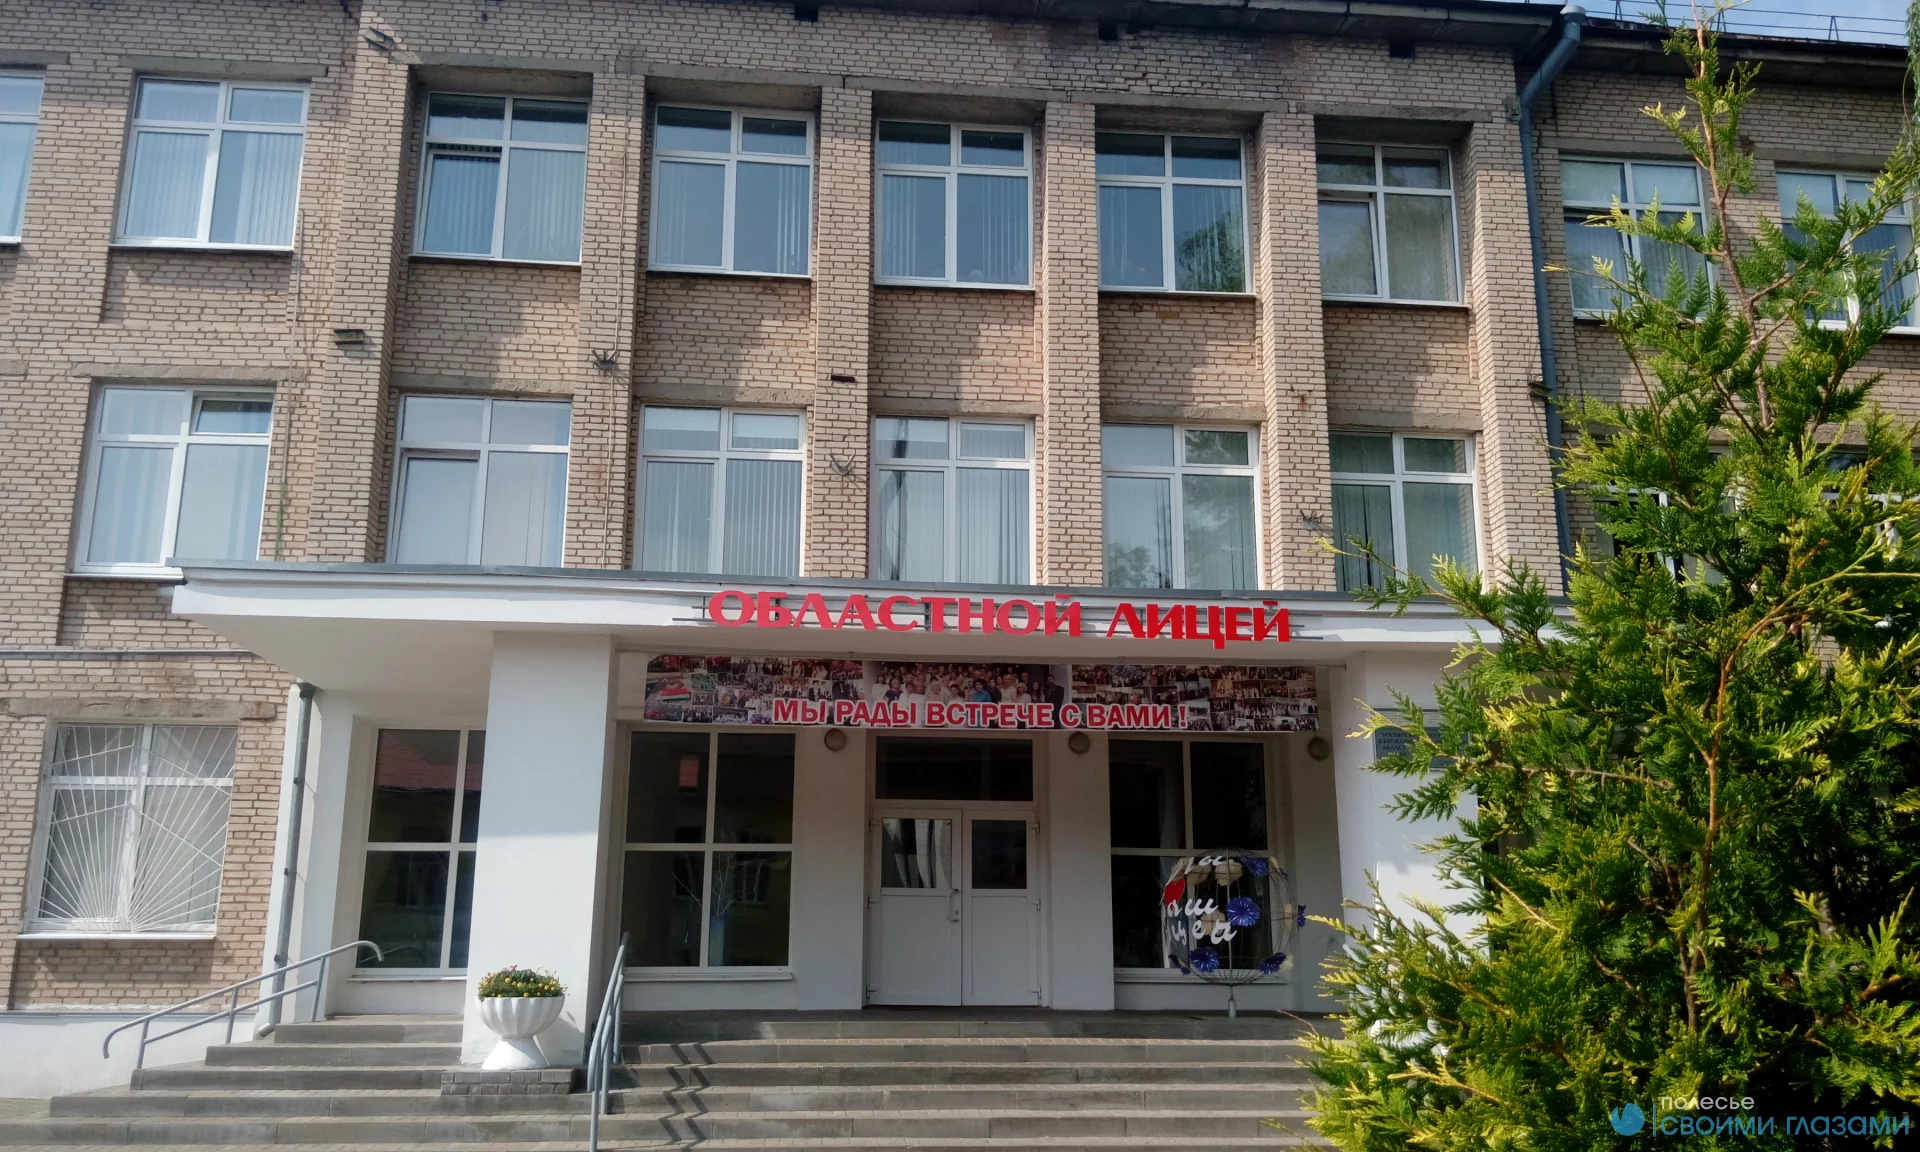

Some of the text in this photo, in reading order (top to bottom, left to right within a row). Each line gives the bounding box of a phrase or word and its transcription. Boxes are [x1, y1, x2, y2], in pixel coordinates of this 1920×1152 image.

[708, 590, 1290, 649] ОБЛАСТНОЙ ЛИЦЕЙ
[774, 700, 825, 724] МЫ
[836, 701, 916, 727] РАДЫ
[926, 703, 1053, 728] ВСТРЕЧЕ
[1061, 704, 1080, 727] С
